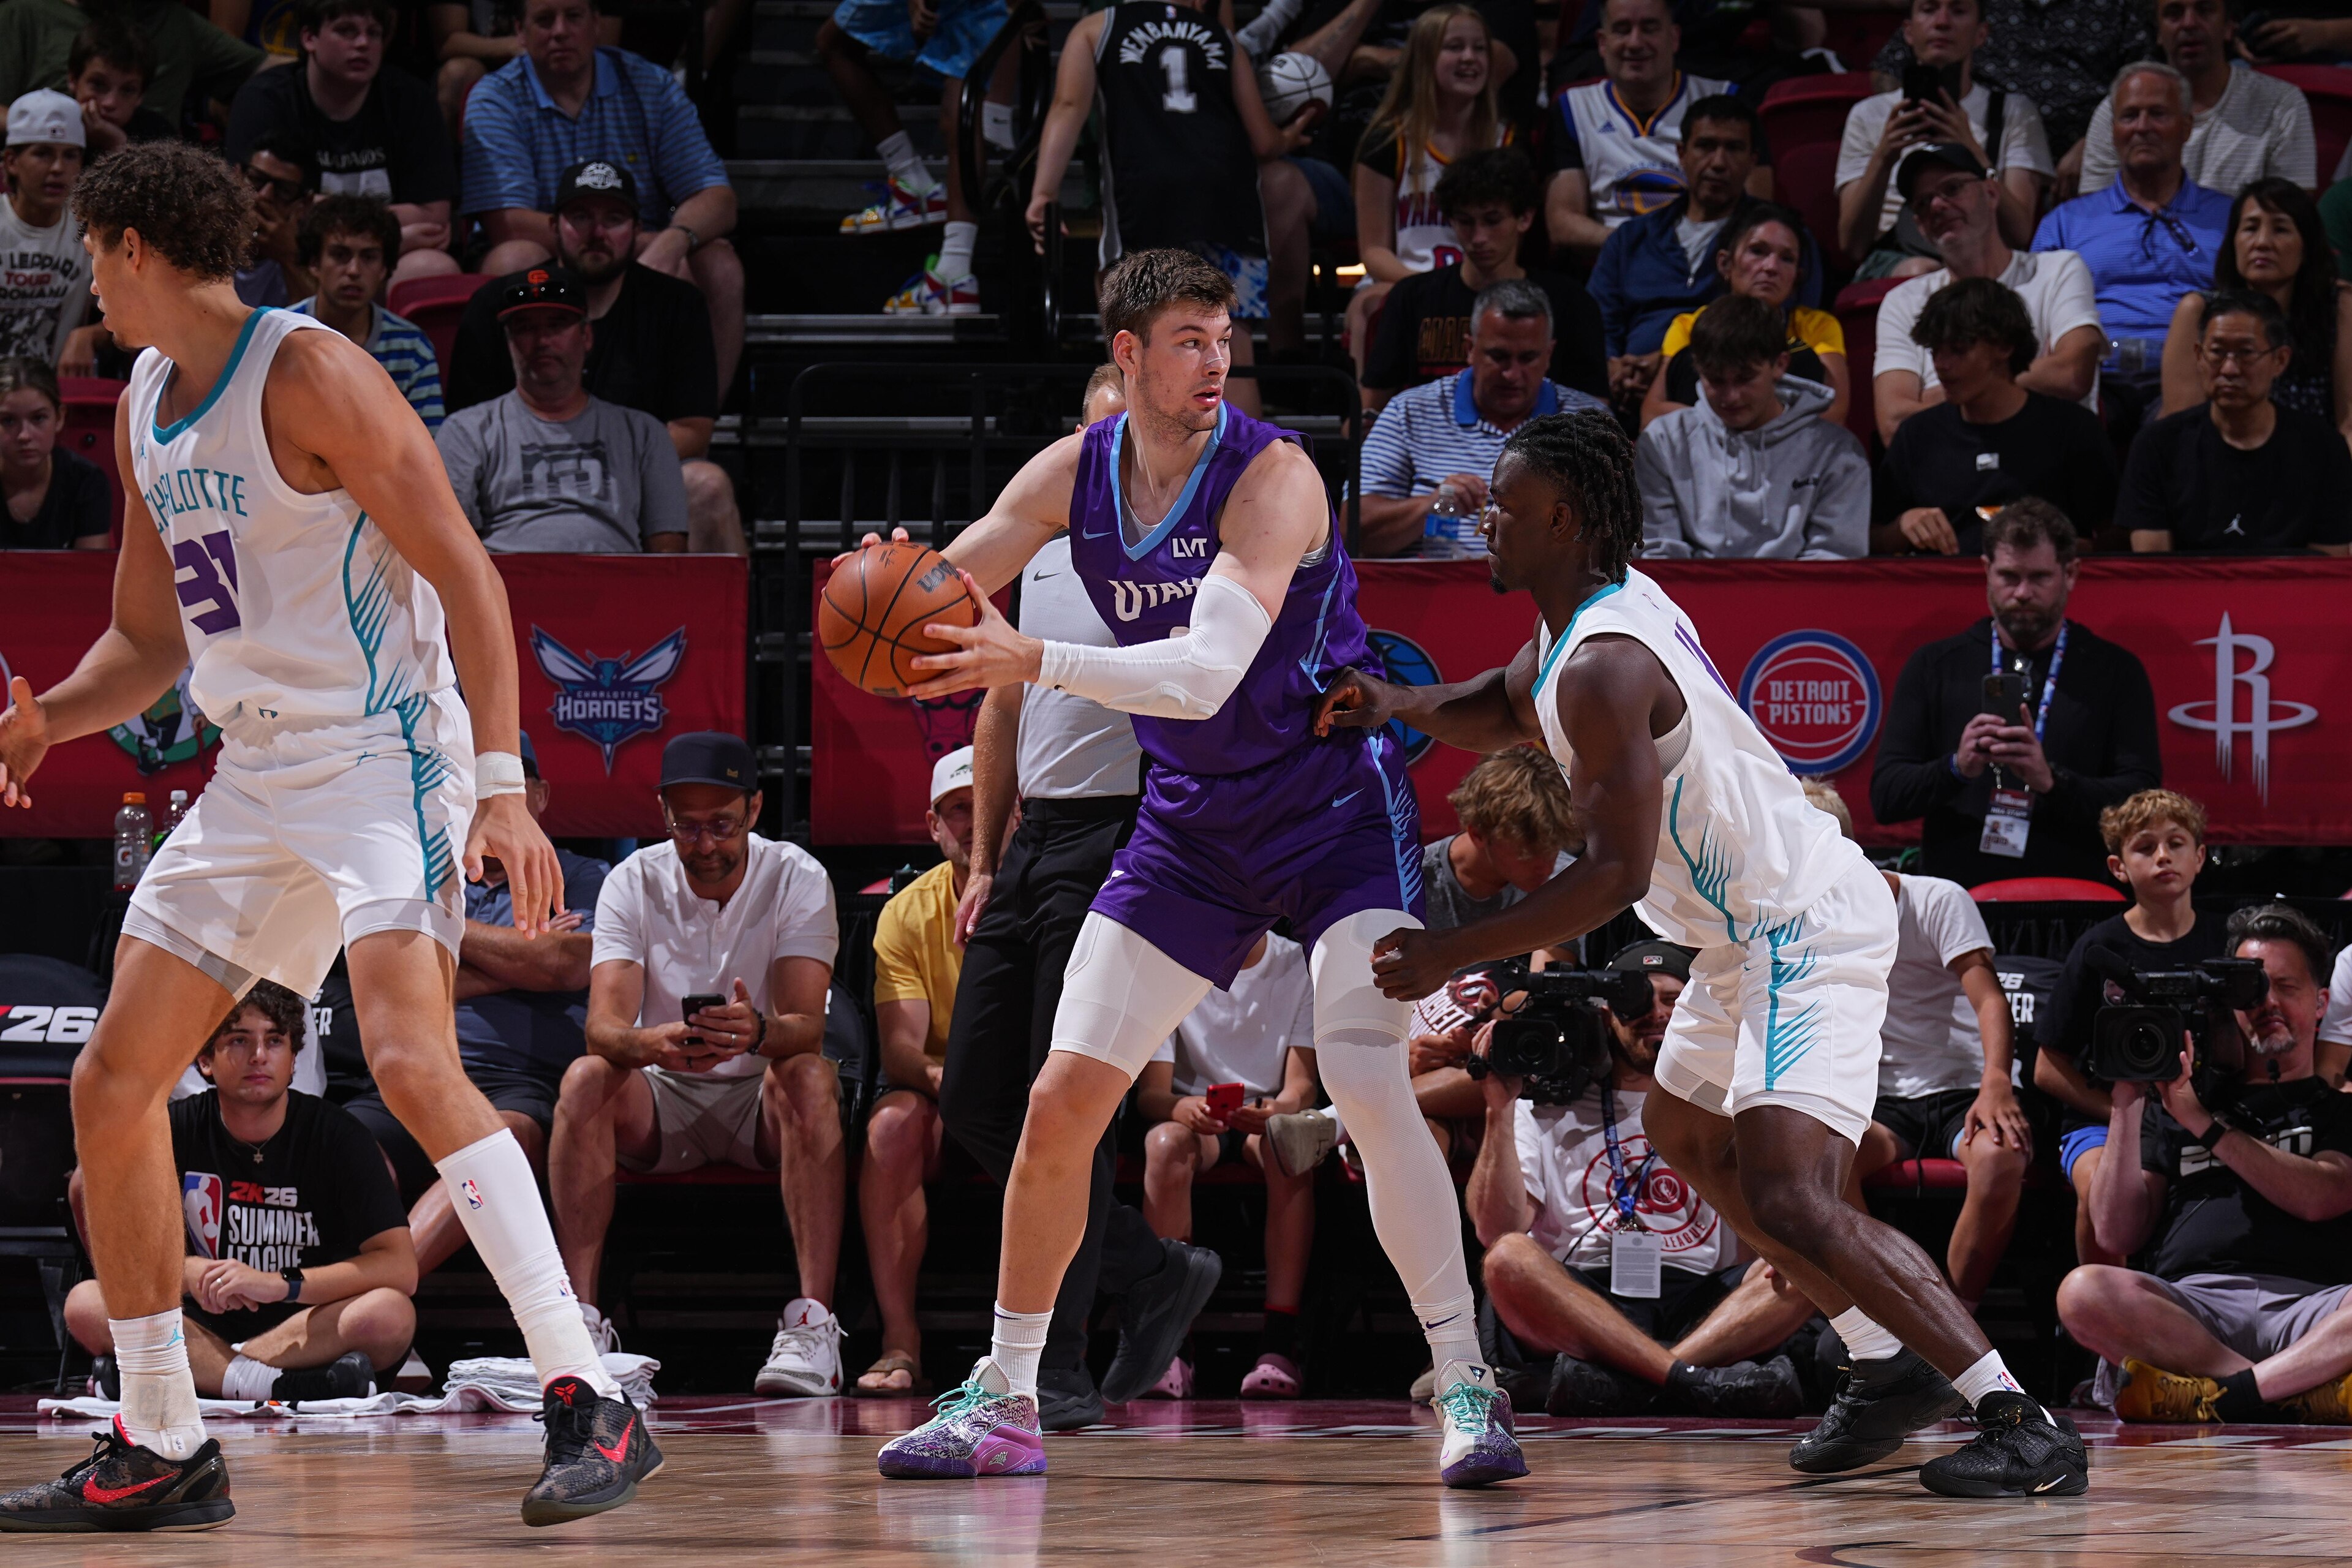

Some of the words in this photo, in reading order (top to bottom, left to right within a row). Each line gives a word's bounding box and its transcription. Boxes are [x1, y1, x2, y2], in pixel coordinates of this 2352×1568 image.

[1119, 21, 1228, 70] WEMBANYAMA
[1159, 45, 1197, 113] 1
[1172, 538, 1208, 558] LVT
[1107, 576, 1202, 622] UTAH
[576, 690, 640, 699] CHARLOTTE
[1768, 680, 1850, 701] DETROIT
[557, 696, 661, 723] HORNETS
[1767, 703, 1852, 725] PISTONS
[0, 1005, 99, 1043] 26
[2180, 1126, 2307, 1177] EN
[228, 1180, 298, 1208] 2K26
[227, 1204, 321, 1247] SUMMER
[1664, 1220, 1706, 1248] LEAGUE
